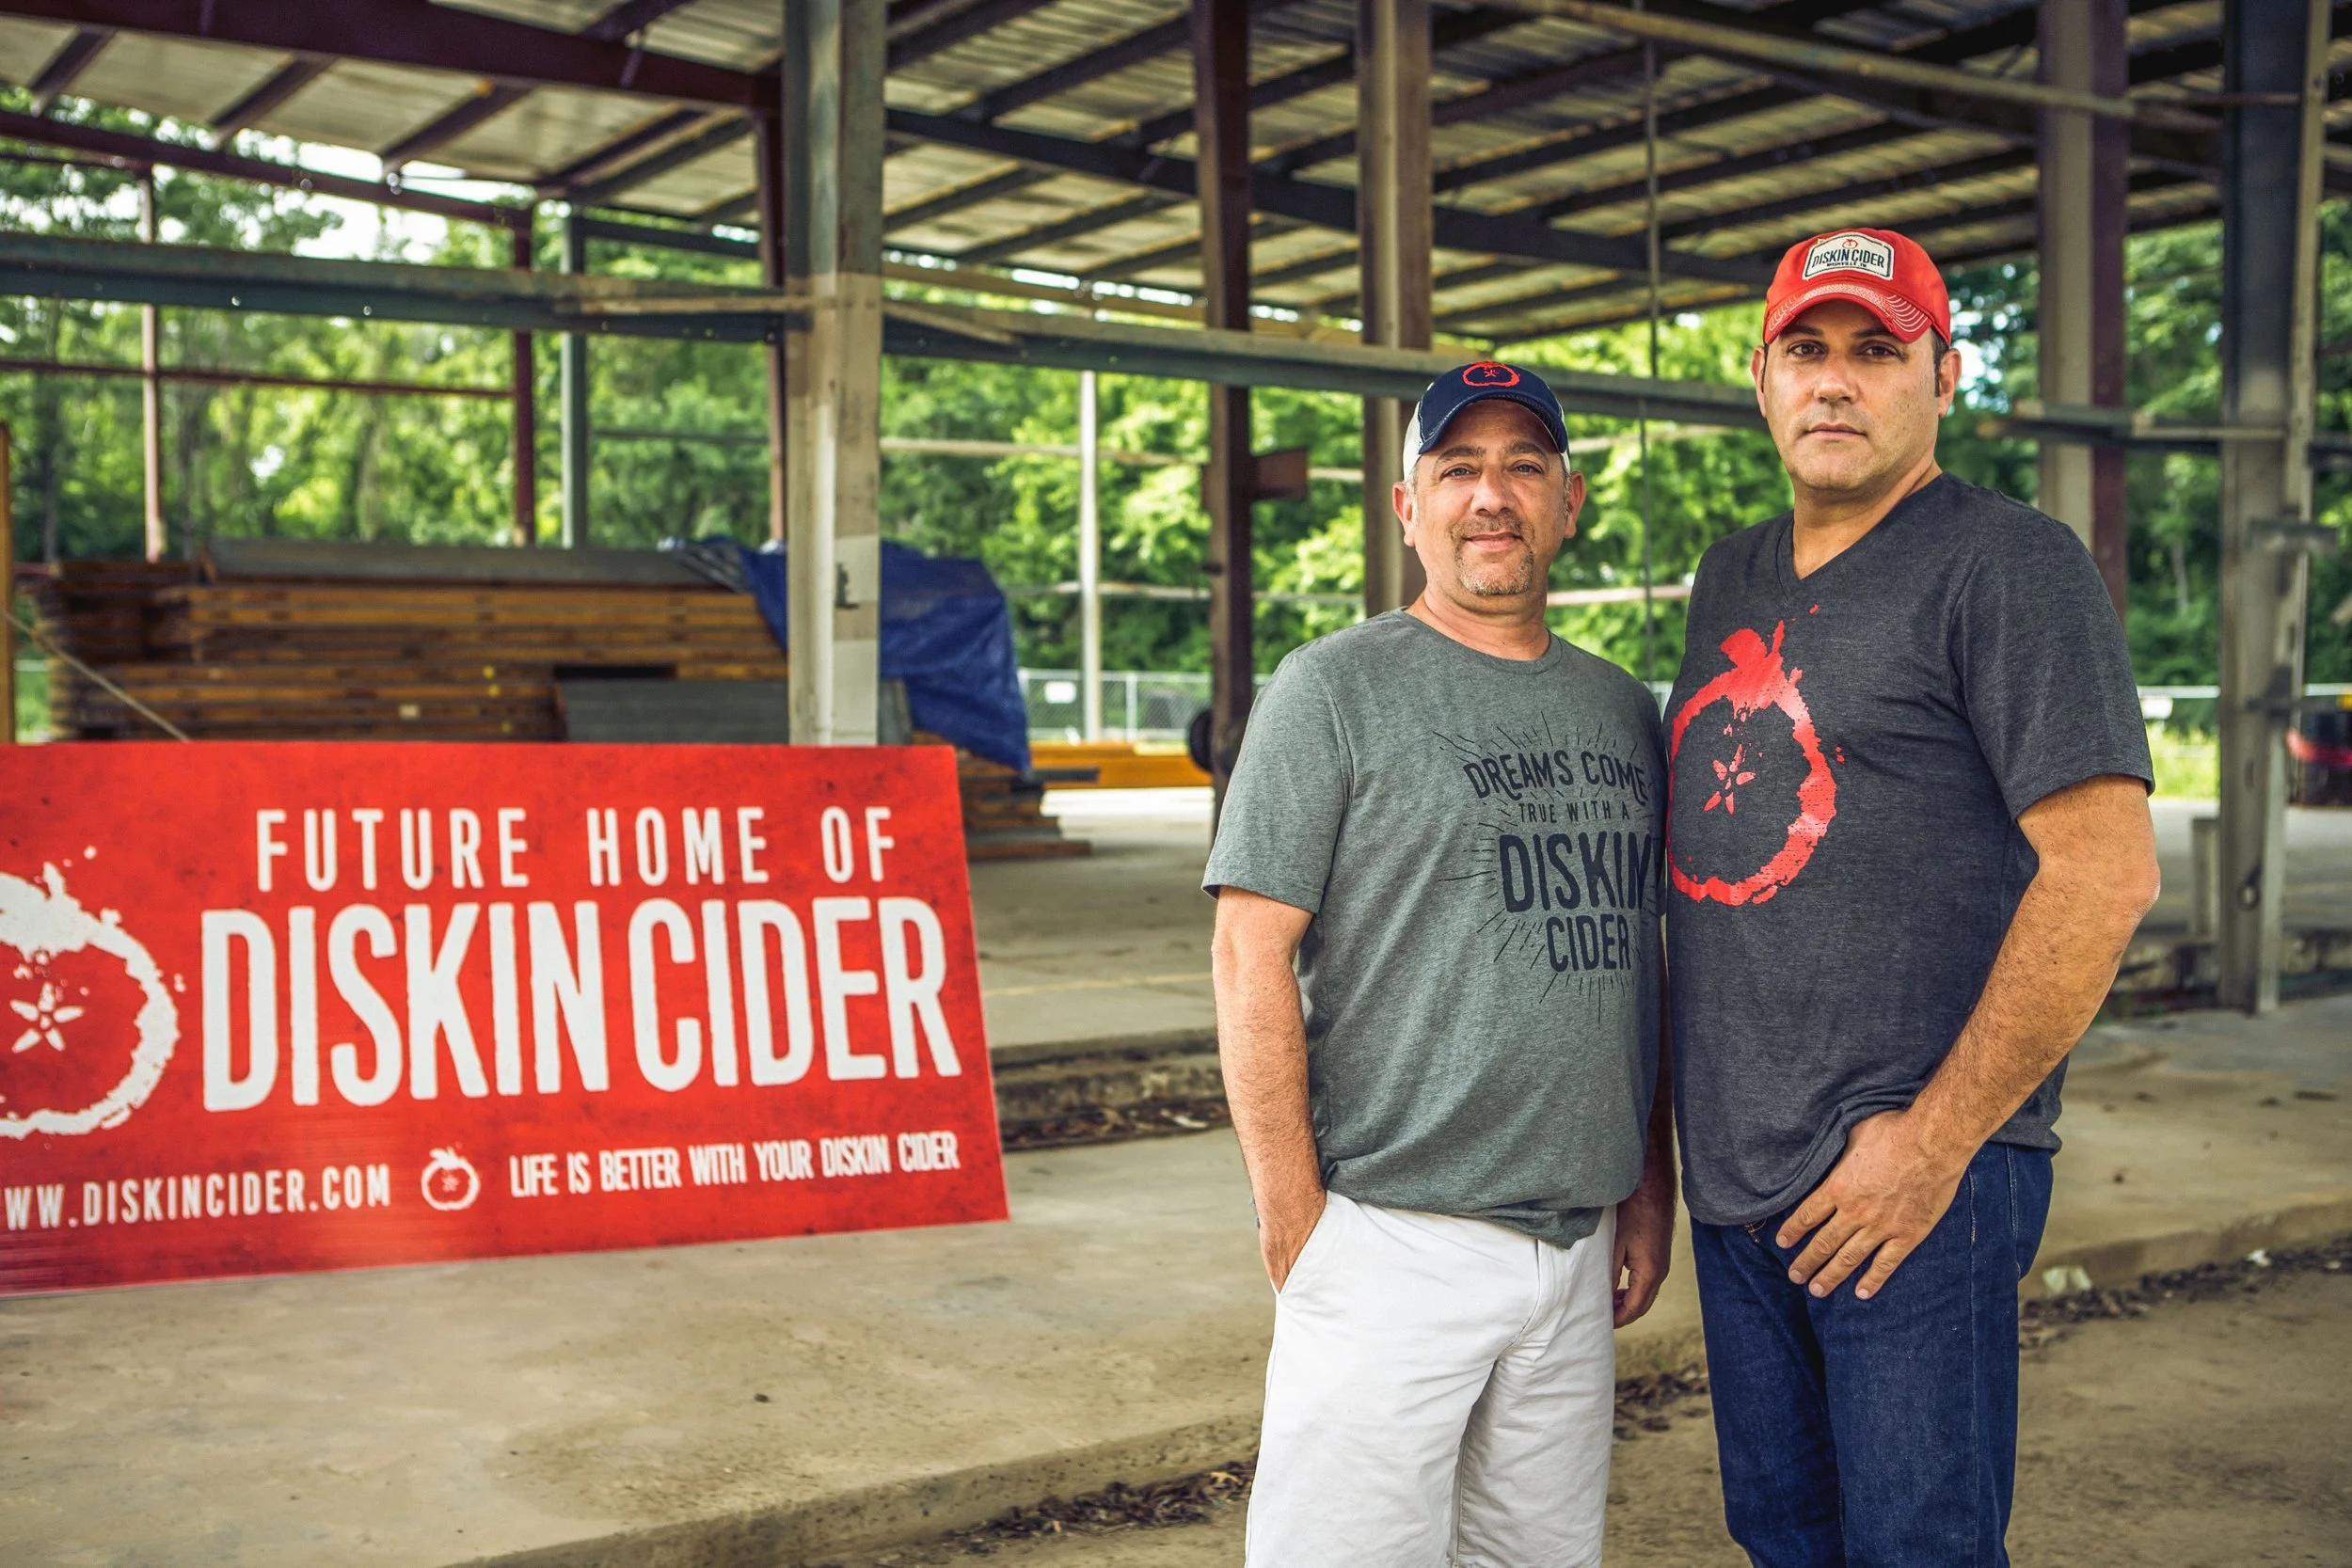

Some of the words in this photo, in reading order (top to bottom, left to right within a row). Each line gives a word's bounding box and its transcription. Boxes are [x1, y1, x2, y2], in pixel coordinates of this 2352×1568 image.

[1812, 249, 1850, 267] DISKIN
[1851, 249, 1884, 268] CIDER
[1463, 750, 1574, 800] DREAMS
[1581, 751, 1648, 806] COME
[1518, 802, 1557, 824] TRUE
[1566, 800, 1612, 823] WITH
[1621, 802, 1630, 821] A
[257, 809, 529, 892] FUTURE
[587, 807, 770, 887] HOME
[820, 806, 895, 883] OF
[1499, 832, 1652, 913] DISKIN
[1546, 913, 1631, 973] CIDER
[201, 901, 610, 1112] DISKIN
[628, 896, 961, 1092] CIDER
[510, 1154, 559, 1197] LIFE
[567, 1152, 591, 1194] IS
[599, 1148, 682, 1192] BETTER
[689, 1144, 746, 1186] WITH
[753, 1139, 814, 1181] YOUR
[820, 1134, 890, 1178] DISKIN
[898, 1132, 961, 1174] CIDER
[4, 1164, 391, 1231] WW.DISKINCIDER.COM
